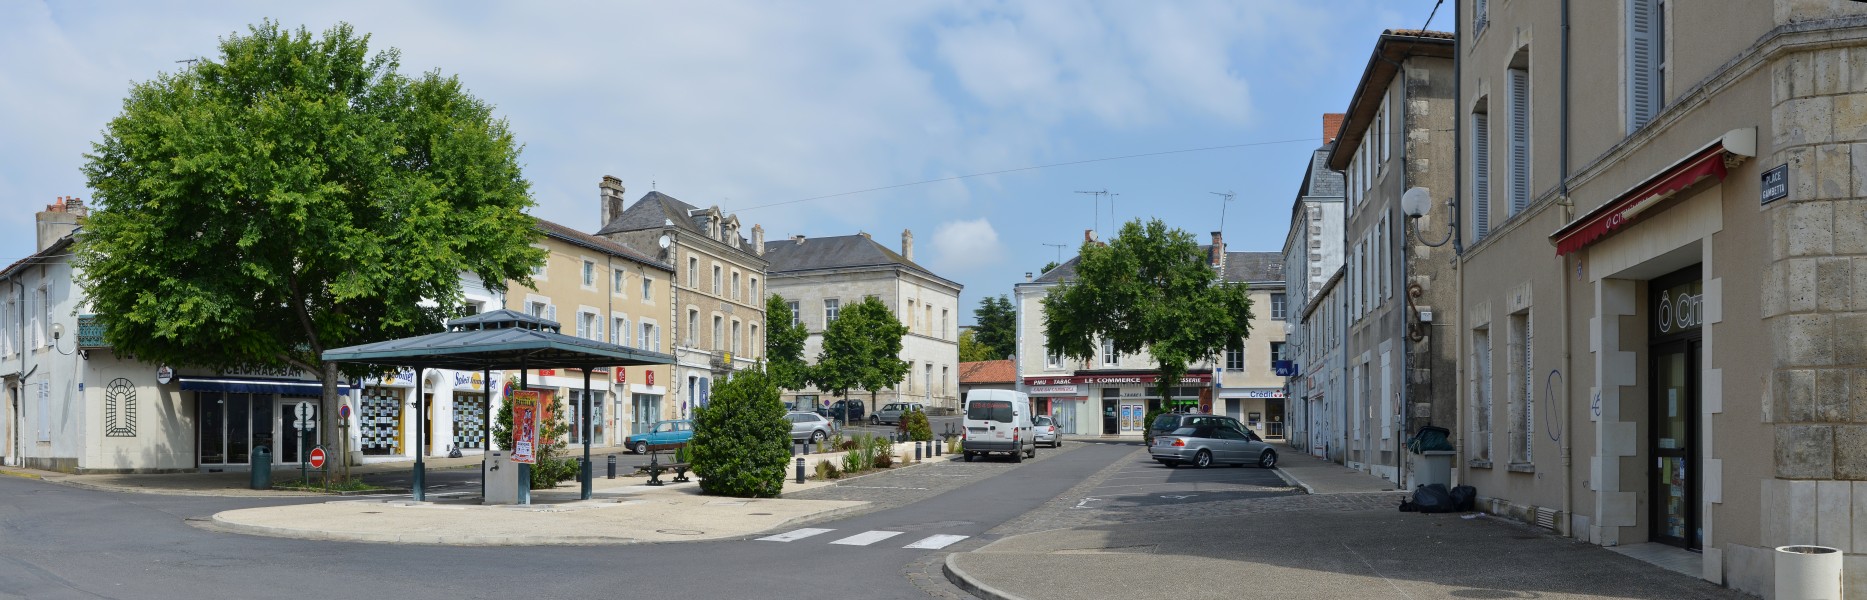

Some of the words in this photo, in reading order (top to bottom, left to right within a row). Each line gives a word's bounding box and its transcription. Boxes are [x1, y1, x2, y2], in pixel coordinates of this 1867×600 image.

[1766, 171, 1782, 185] PLACE
[1762, 183, 1785, 199] GAMBETTA
[1658, 289, 1673, 333] Ô
[1276, 367, 1289, 375] AXA
[455, 371, 470, 387] Soleil
[470, 376, 497, 389] Immoier
[1250, 390, 1273, 398] Crédit
